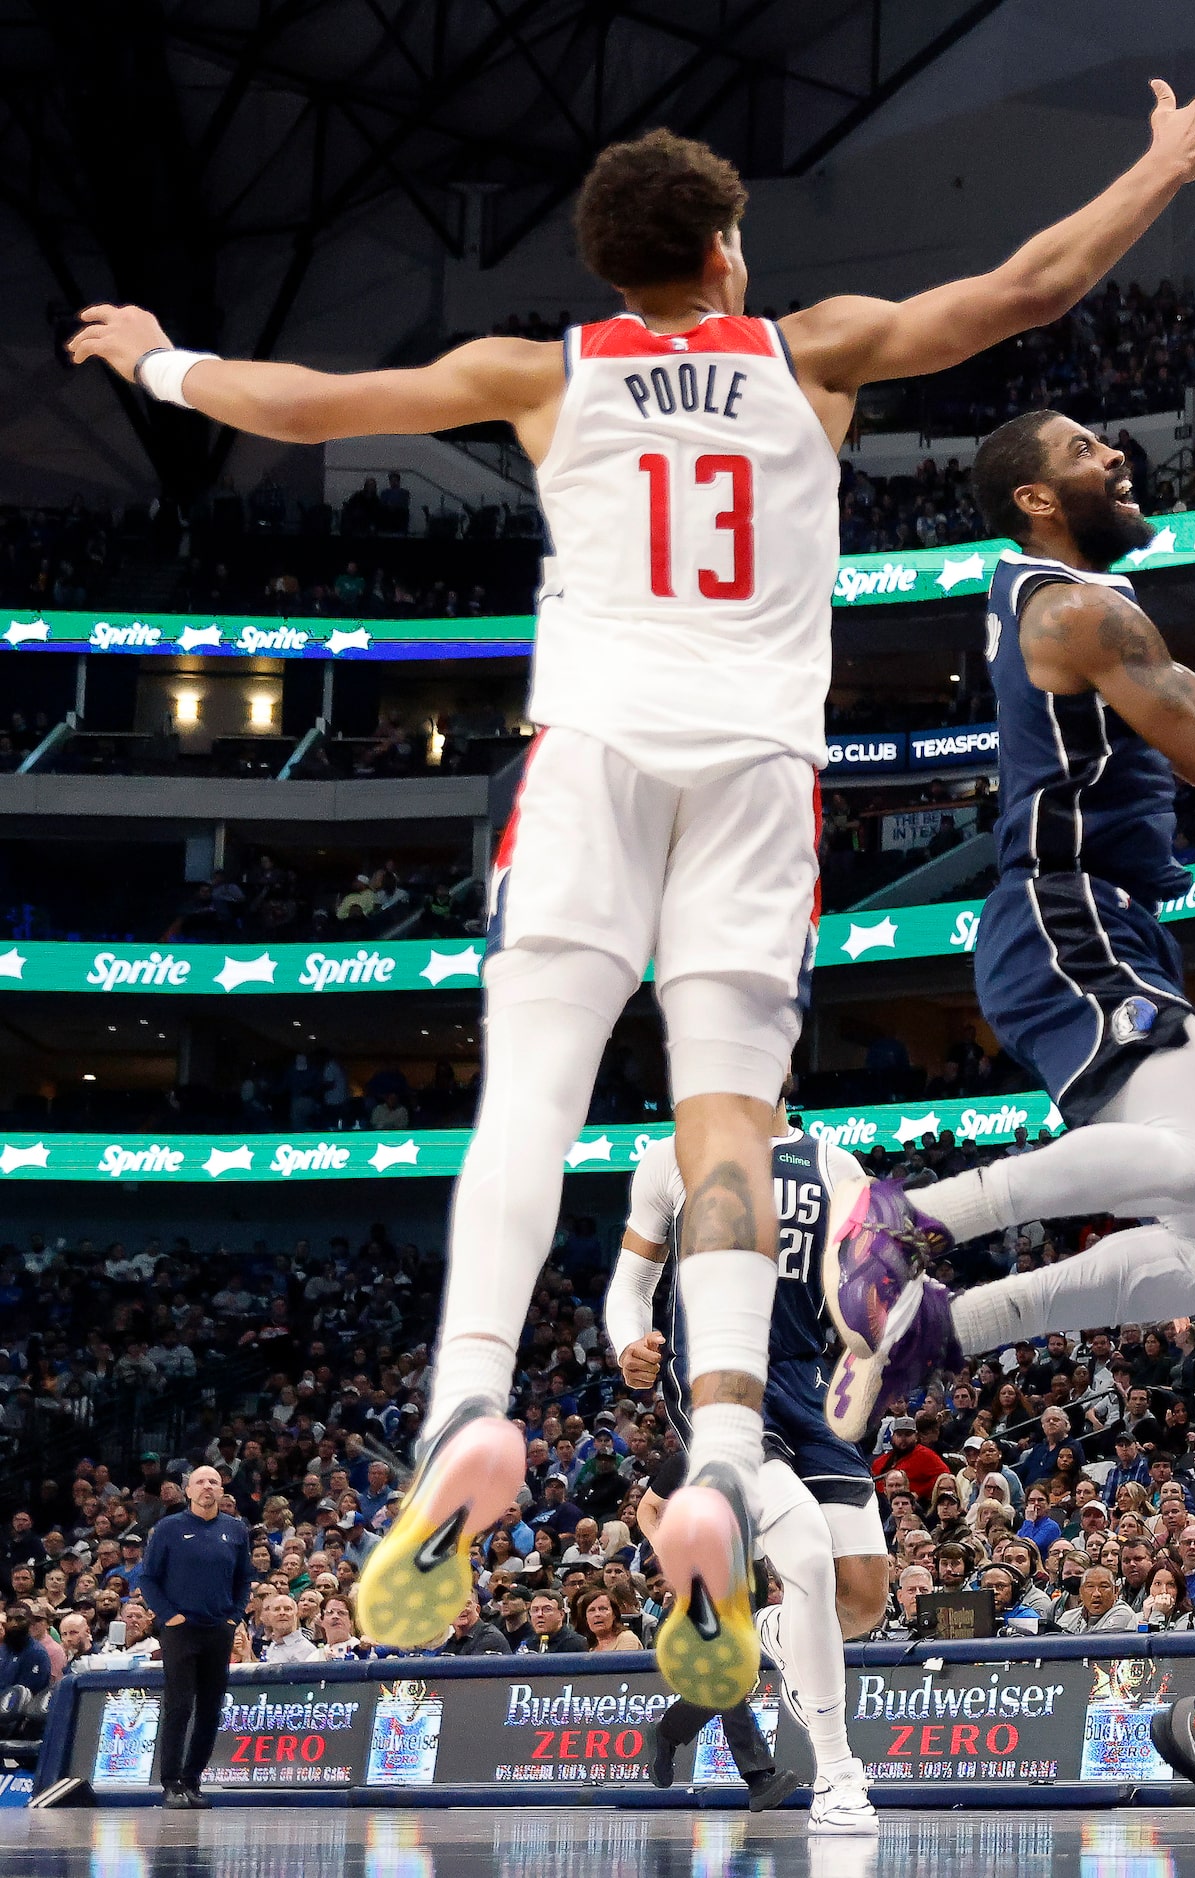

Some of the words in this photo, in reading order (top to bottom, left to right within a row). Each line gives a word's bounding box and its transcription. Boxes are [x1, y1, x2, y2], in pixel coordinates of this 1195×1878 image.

[624, 363, 747, 419] POOLE
[638, 453, 755, 601] 13
[835, 563, 917, 601] Sprite
[90, 621, 161, 649] Sprite
[237, 626, 309, 653] Sprite
[845, 743, 897, 762] CLUB
[87, 951, 191, 991] Sprite
[299, 950, 396, 991] Sprite
[809, 1117, 877, 1147] Sprite
[955, 1105, 1027, 1141] Sprite
[98, 1144, 184, 1177] Sprite
[270, 1142, 351, 1176] Sprite
[779, 1153, 811, 1167] chime
[779, 1228, 814, 1284] 21
[504, 1683, 681, 1727] Budweiser
[854, 1673, 1063, 1719] Budweiser
[231, 1735, 325, 1763] ZERO
[531, 1729, 643, 1759] ZERO
[887, 1723, 1019, 1755] ZERO
[323, 1766, 352, 1783] GAME
[557, 1764, 587, 1780] 100%
[918, 1760, 952, 1779] 100%
[980, 1760, 1016, 1779] YOUR
[1019, 1760, 1058, 1779] GAME
